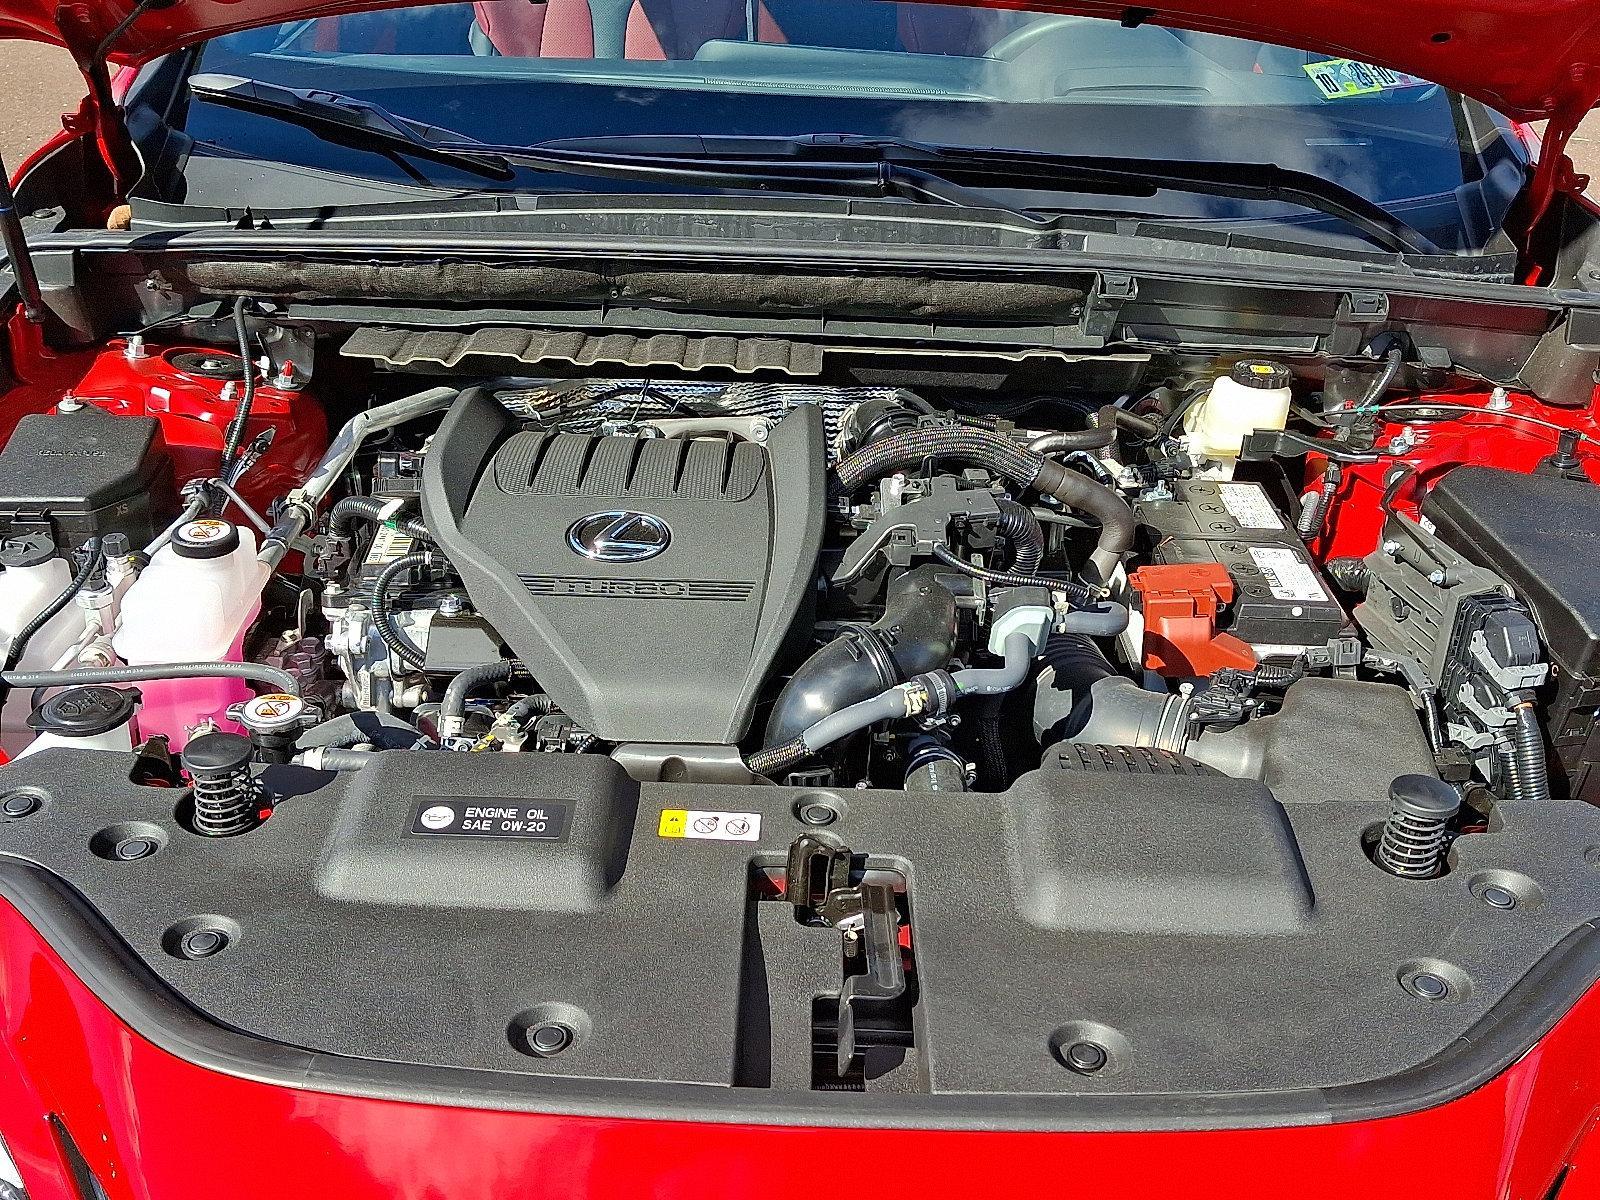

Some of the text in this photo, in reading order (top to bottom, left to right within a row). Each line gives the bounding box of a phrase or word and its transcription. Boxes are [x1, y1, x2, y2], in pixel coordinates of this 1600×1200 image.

[1316, 73, 1340, 93] 10
[554, 579, 689, 596] TURBO
[464, 807, 549, 820] ENGINE OIL
[461, 819, 546, 832] SAE 0W-20
